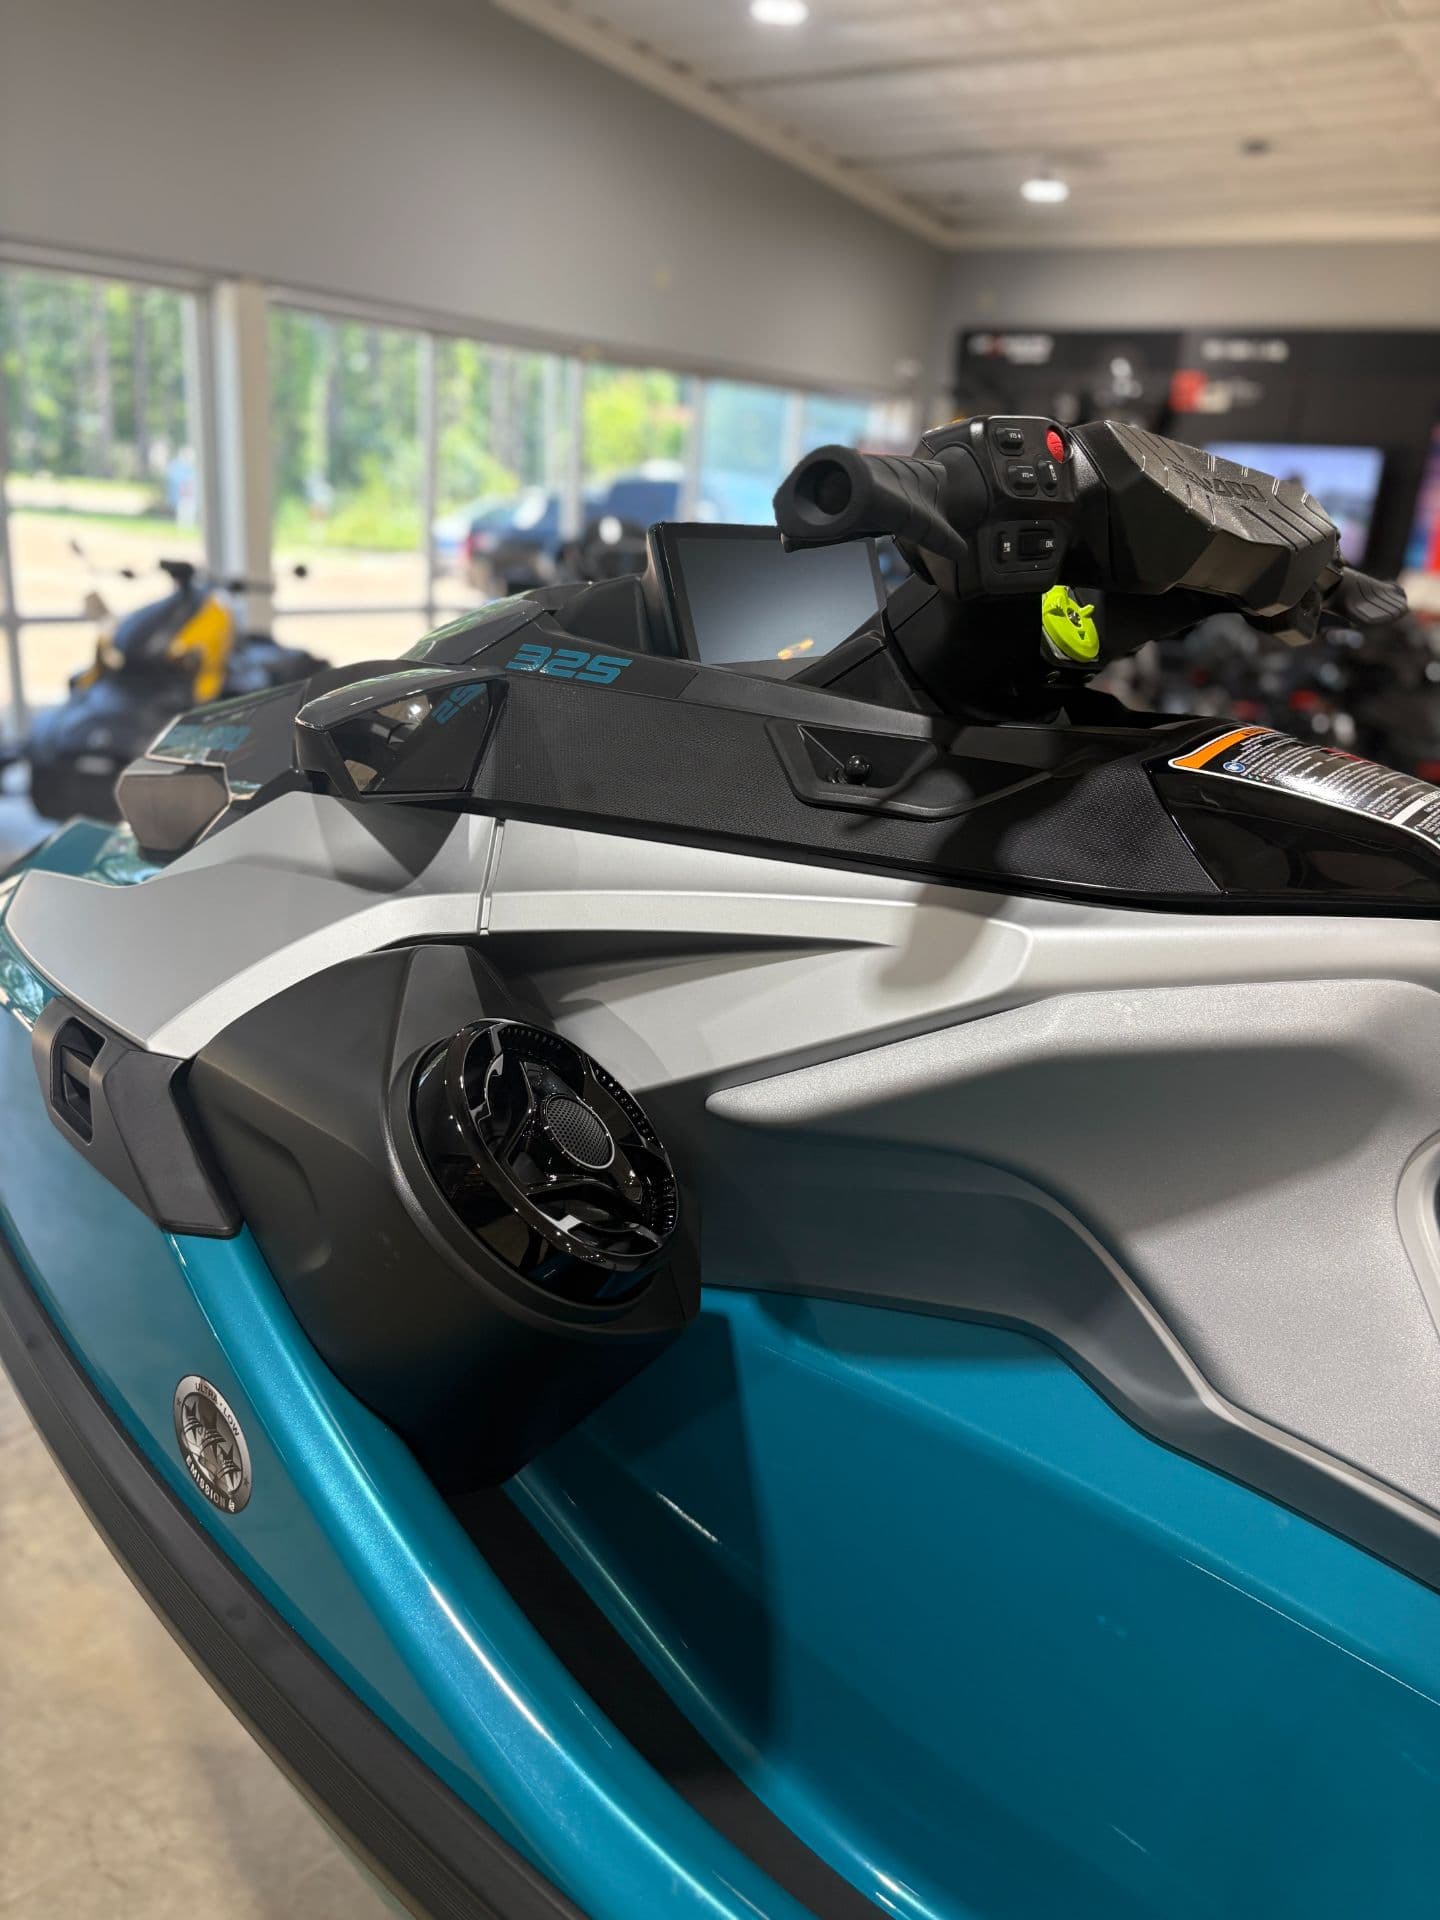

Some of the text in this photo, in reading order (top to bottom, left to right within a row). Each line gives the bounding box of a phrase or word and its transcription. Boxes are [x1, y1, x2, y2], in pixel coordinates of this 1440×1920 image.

[1045, 540, 1054, 548] OK
[505, 643, 633, 685] 325
[194, 1382, 240, 1436] ULTRA LOW
[186, 1455, 226, 1509] EMISSION
